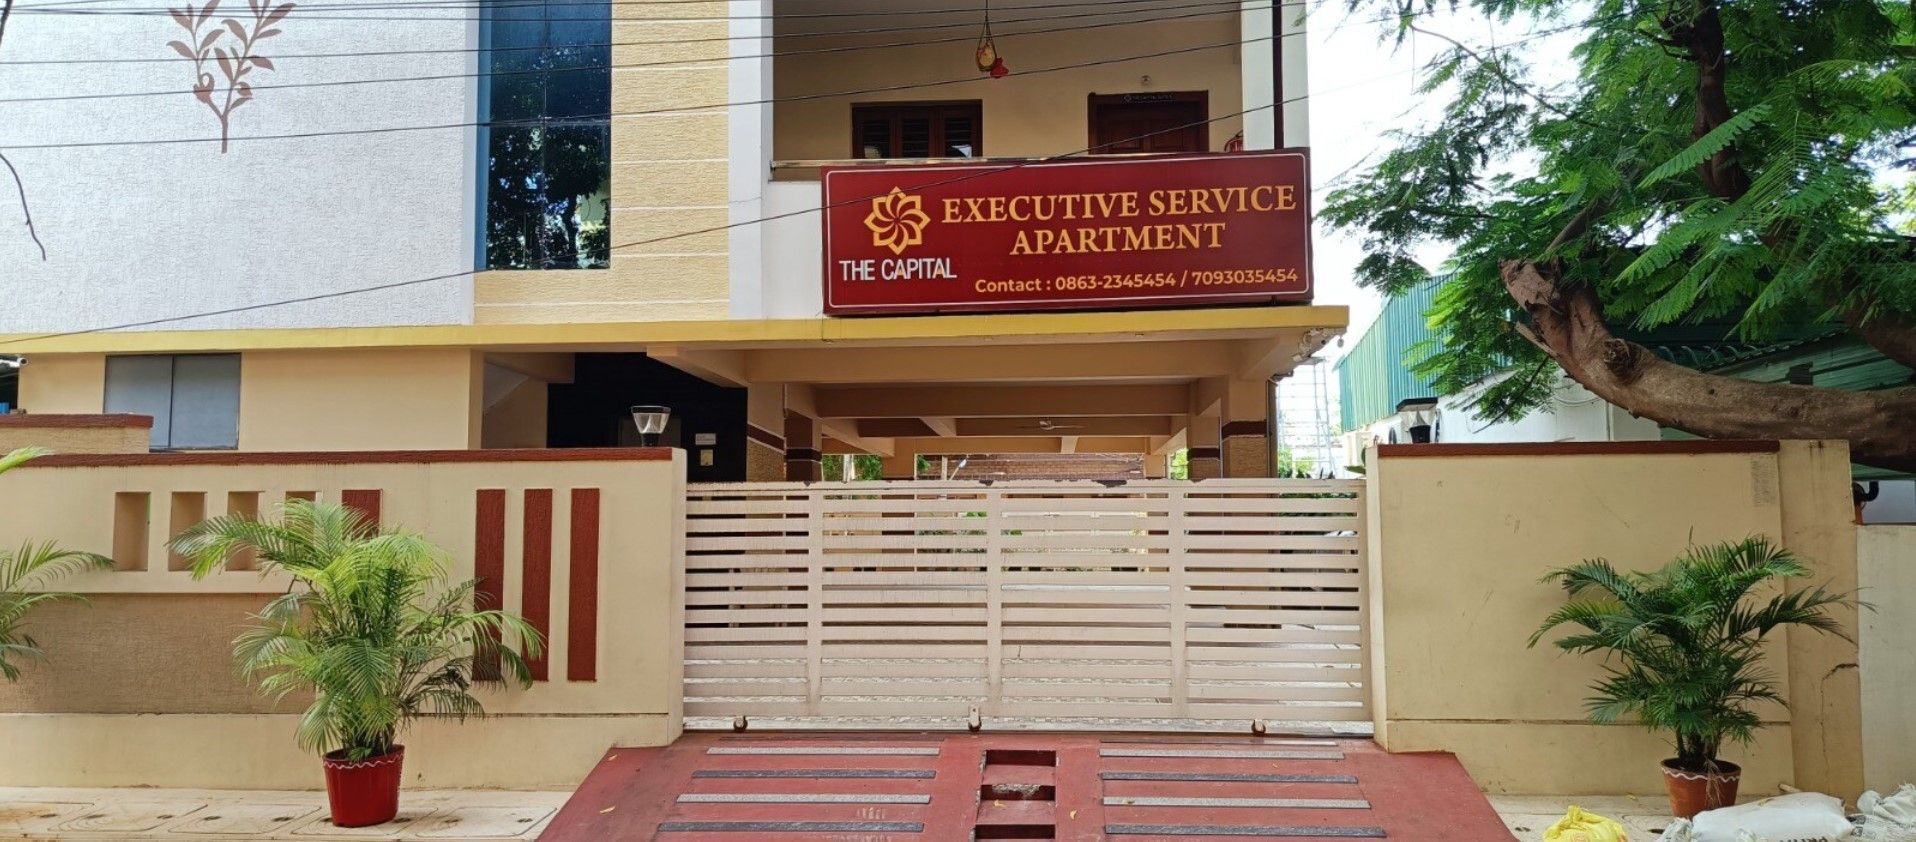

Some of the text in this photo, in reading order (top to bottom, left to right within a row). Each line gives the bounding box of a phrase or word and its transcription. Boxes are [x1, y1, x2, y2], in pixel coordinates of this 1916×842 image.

[942, 184, 1297, 223] EXECUTIVE SERVICE
[1009, 222, 1226, 255] APARTMENT
[839, 258, 957, 281] THE CAPITAL
[975, 278, 1042, 293] Contact
[1055, 273, 1176, 291] 0863-2345454
[1180, 270, 1188, 287] /
[1192, 269, 1298, 286] 7093035454
